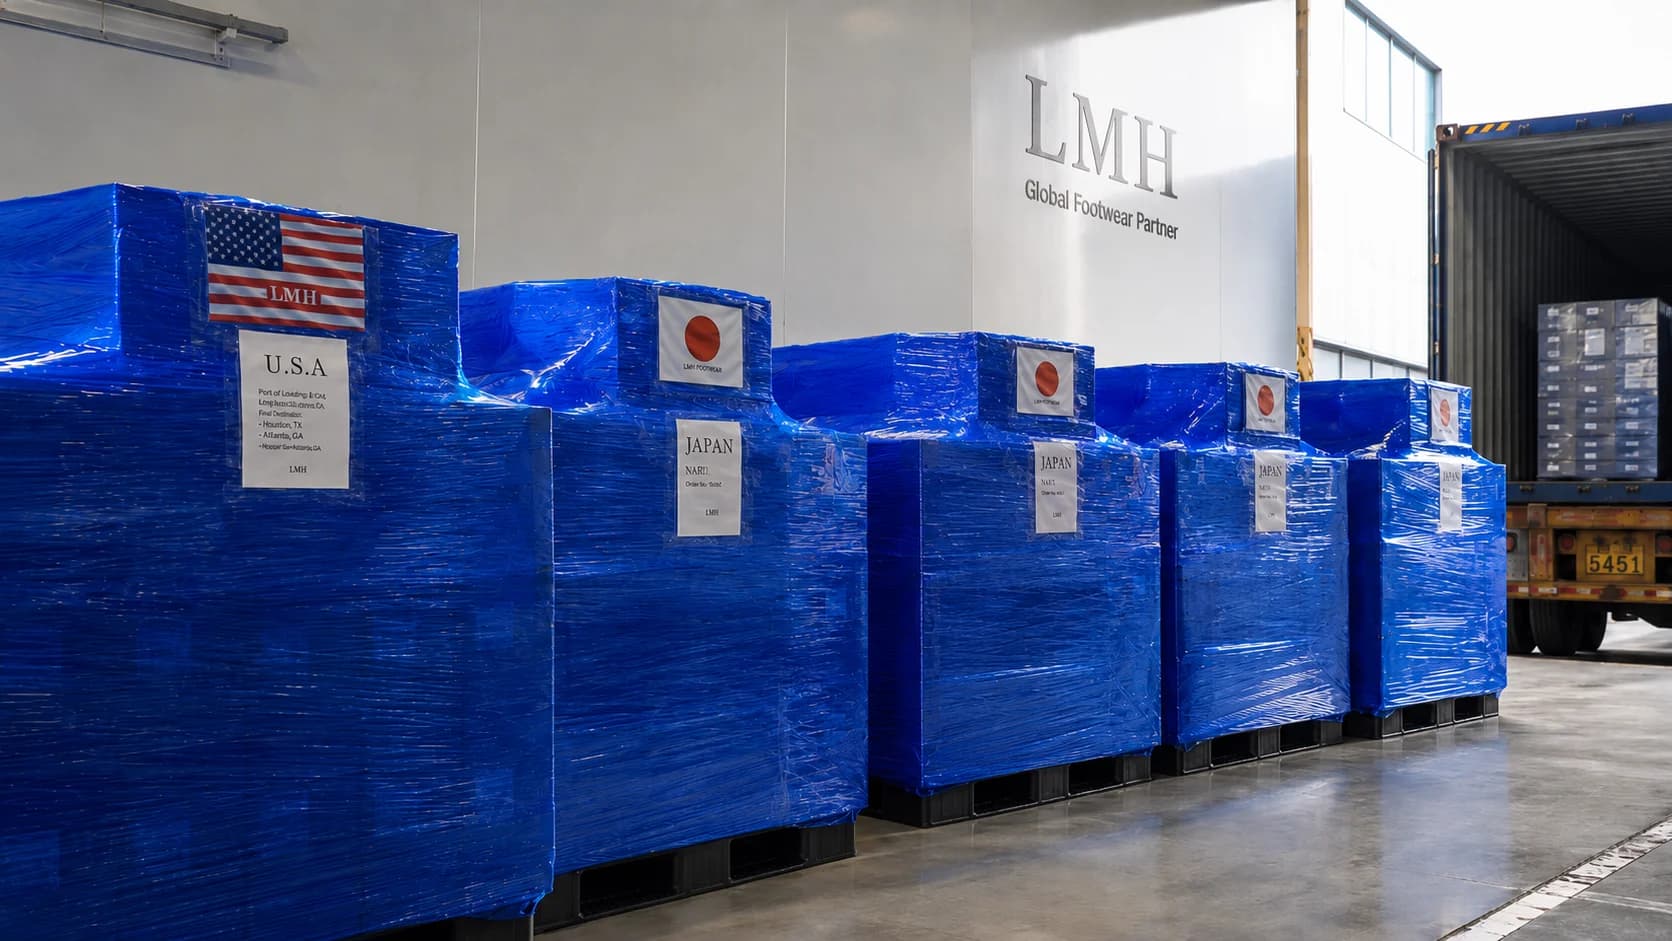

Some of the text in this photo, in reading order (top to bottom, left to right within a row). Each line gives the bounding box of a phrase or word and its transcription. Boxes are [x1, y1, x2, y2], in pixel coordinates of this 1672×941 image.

[1025, 74, 1178, 200] LMH
[1025, 179, 1179, 240] Global Footwear Partner
[269, 285, 318, 306] LMH
[264, 354, 328, 377] U.S.A
[258, 388, 272, 397] Port
[273, 389, 280, 397] of
[293, 421, 303, 429] TX
[685, 436, 734, 456] JAPAN
[289, 465, 307, 473] LMH
[1040, 455, 1072, 471] JAPAN
[1258, 464, 1283, 478] JAPAN
[1589, 555, 1640, 574] 5451
